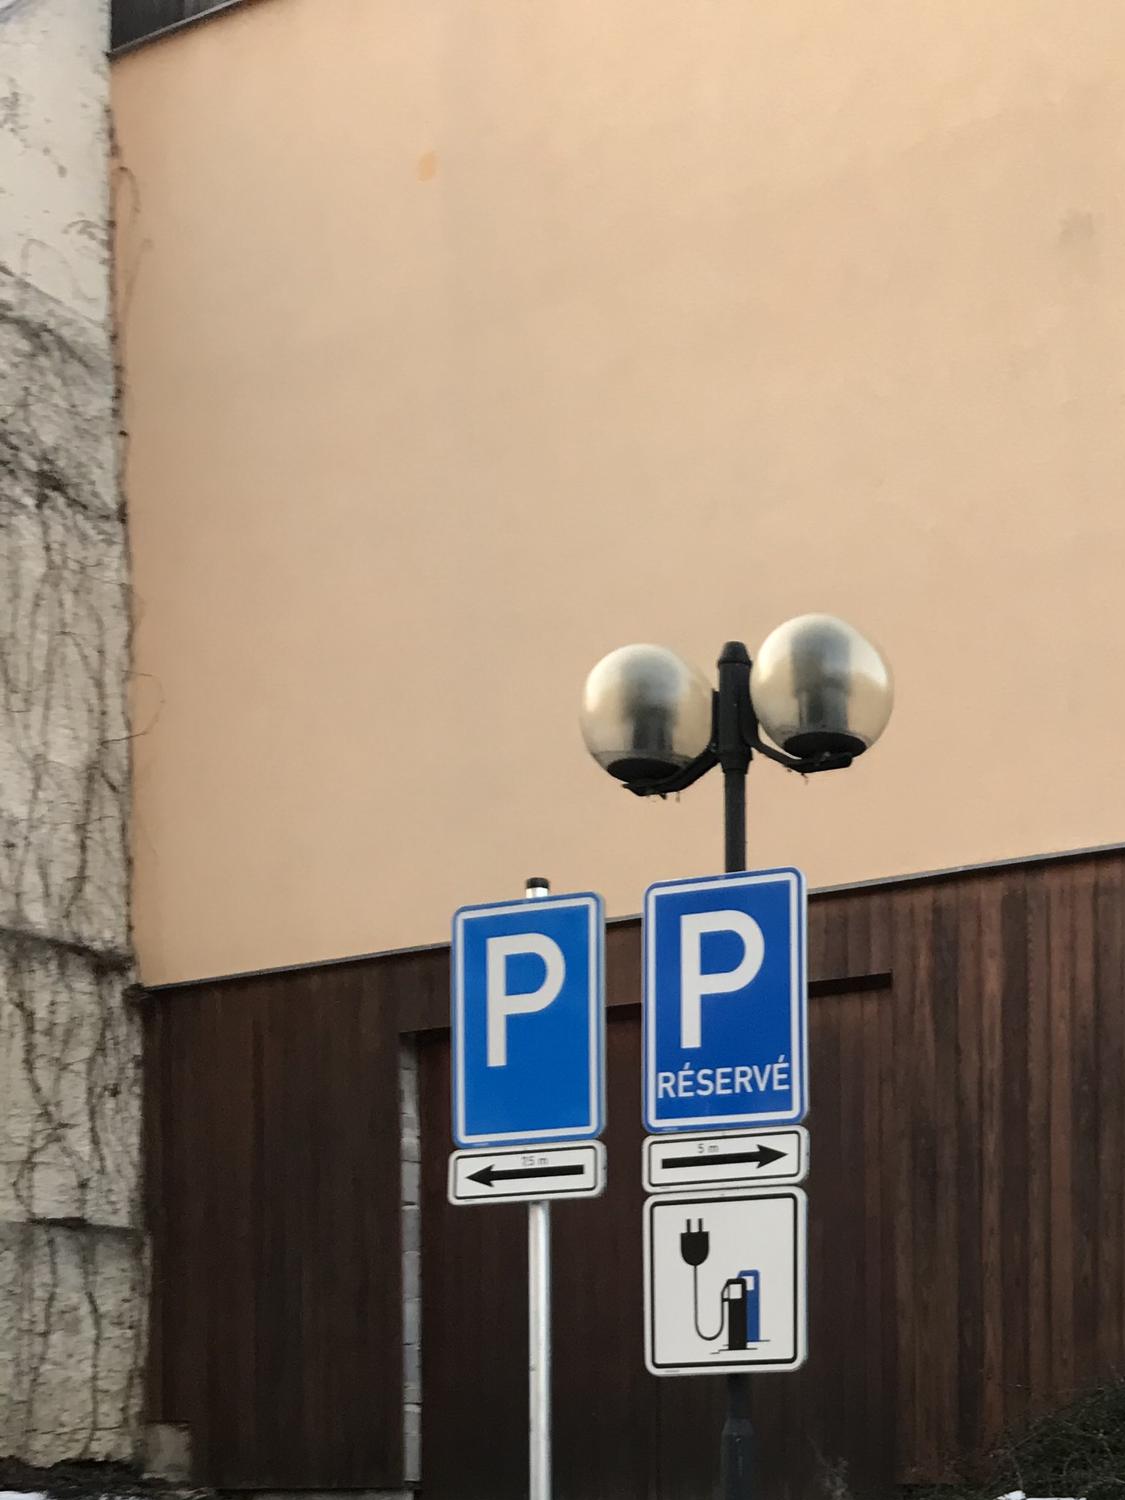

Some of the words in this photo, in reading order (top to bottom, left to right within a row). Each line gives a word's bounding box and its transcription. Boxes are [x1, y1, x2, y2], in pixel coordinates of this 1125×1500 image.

[486, 932, 566, 1067] P
[681, 909, 765, 1049] P
[657, 1054, 790, 1099] RÉSERVÉ
[697, 1143, 705, 1154] 5
[707, 1145, 719, 1153] m
